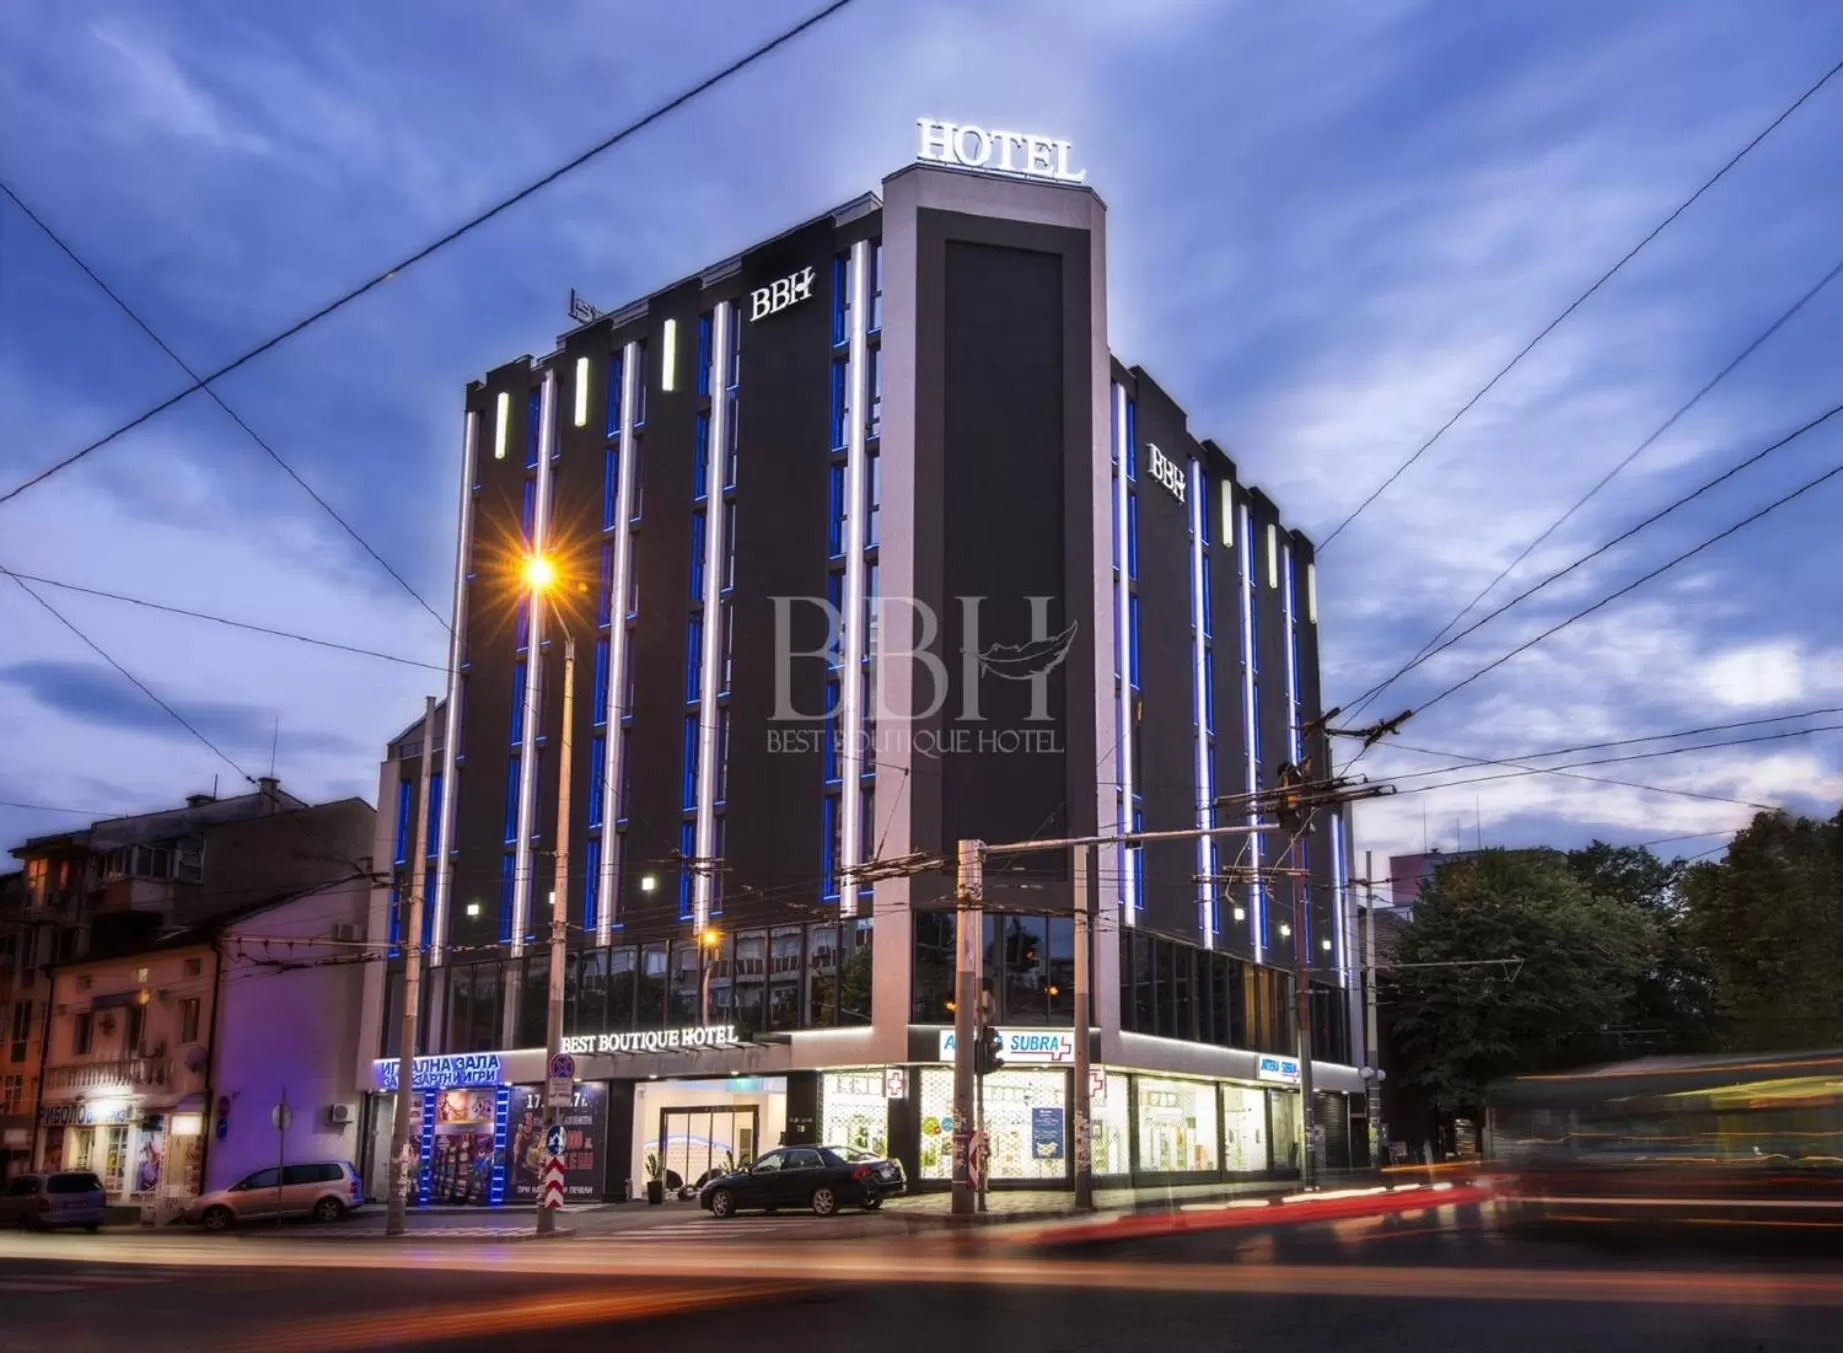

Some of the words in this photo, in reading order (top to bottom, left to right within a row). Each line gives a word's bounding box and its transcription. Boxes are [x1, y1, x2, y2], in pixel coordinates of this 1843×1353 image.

[916, 117, 1086, 183] HOTEL
[750, 266, 816, 322] BBH
[1146, 443, 1186, 503] BBH
[561, 1036, 596, 1053] BEST
[600, 1031, 680, 1052] BOUTIQUE
[681, 1025, 739, 1046] HOTEL
[1010, 1035, 1059, 1051] SUBRA
[381, 1058, 451, 1075] ИГАЛНА
[455, 1054, 499, 1070] ЗАЛА
[463, 1070, 495, 1082] ИГРИ
